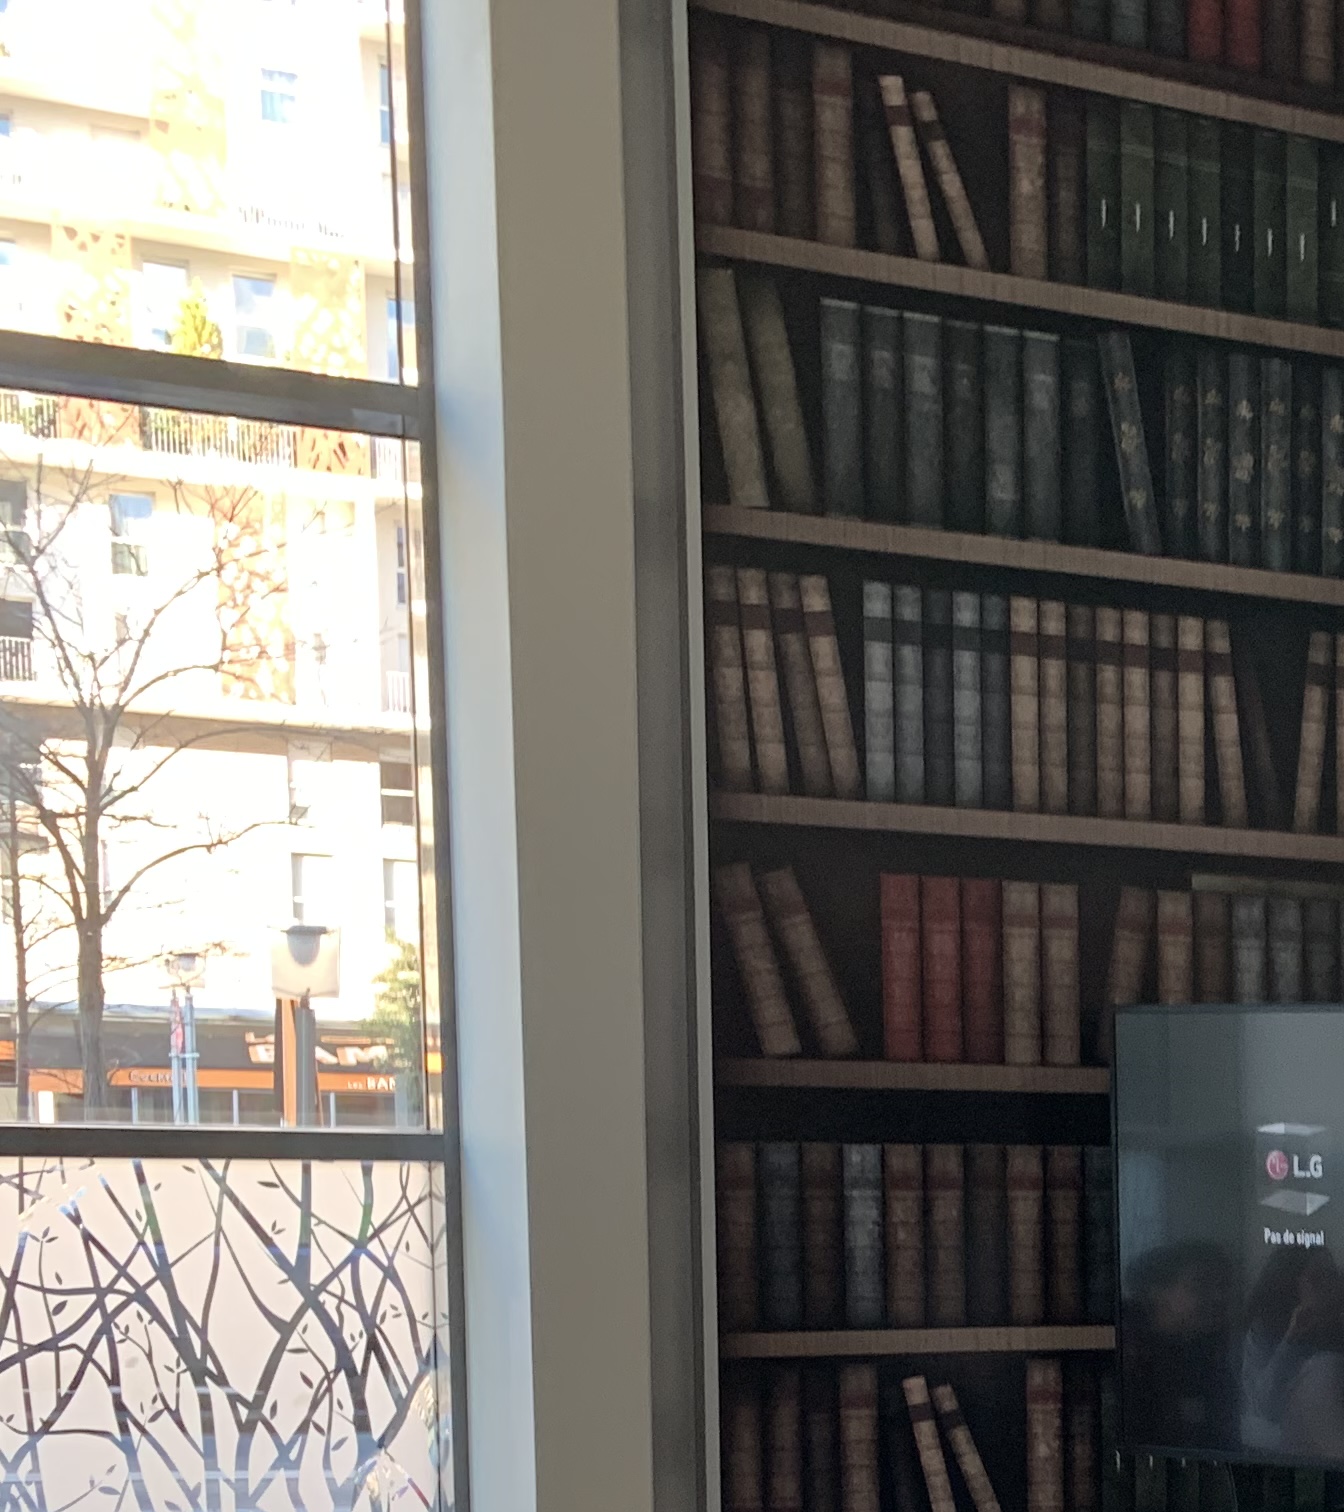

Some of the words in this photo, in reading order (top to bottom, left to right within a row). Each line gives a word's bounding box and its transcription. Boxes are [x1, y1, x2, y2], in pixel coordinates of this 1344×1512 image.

[1263, 1226, 1282, 1244] Pas
[1283, 1228, 1295, 1245] de
[1296, 1228, 1325, 1250] signal
